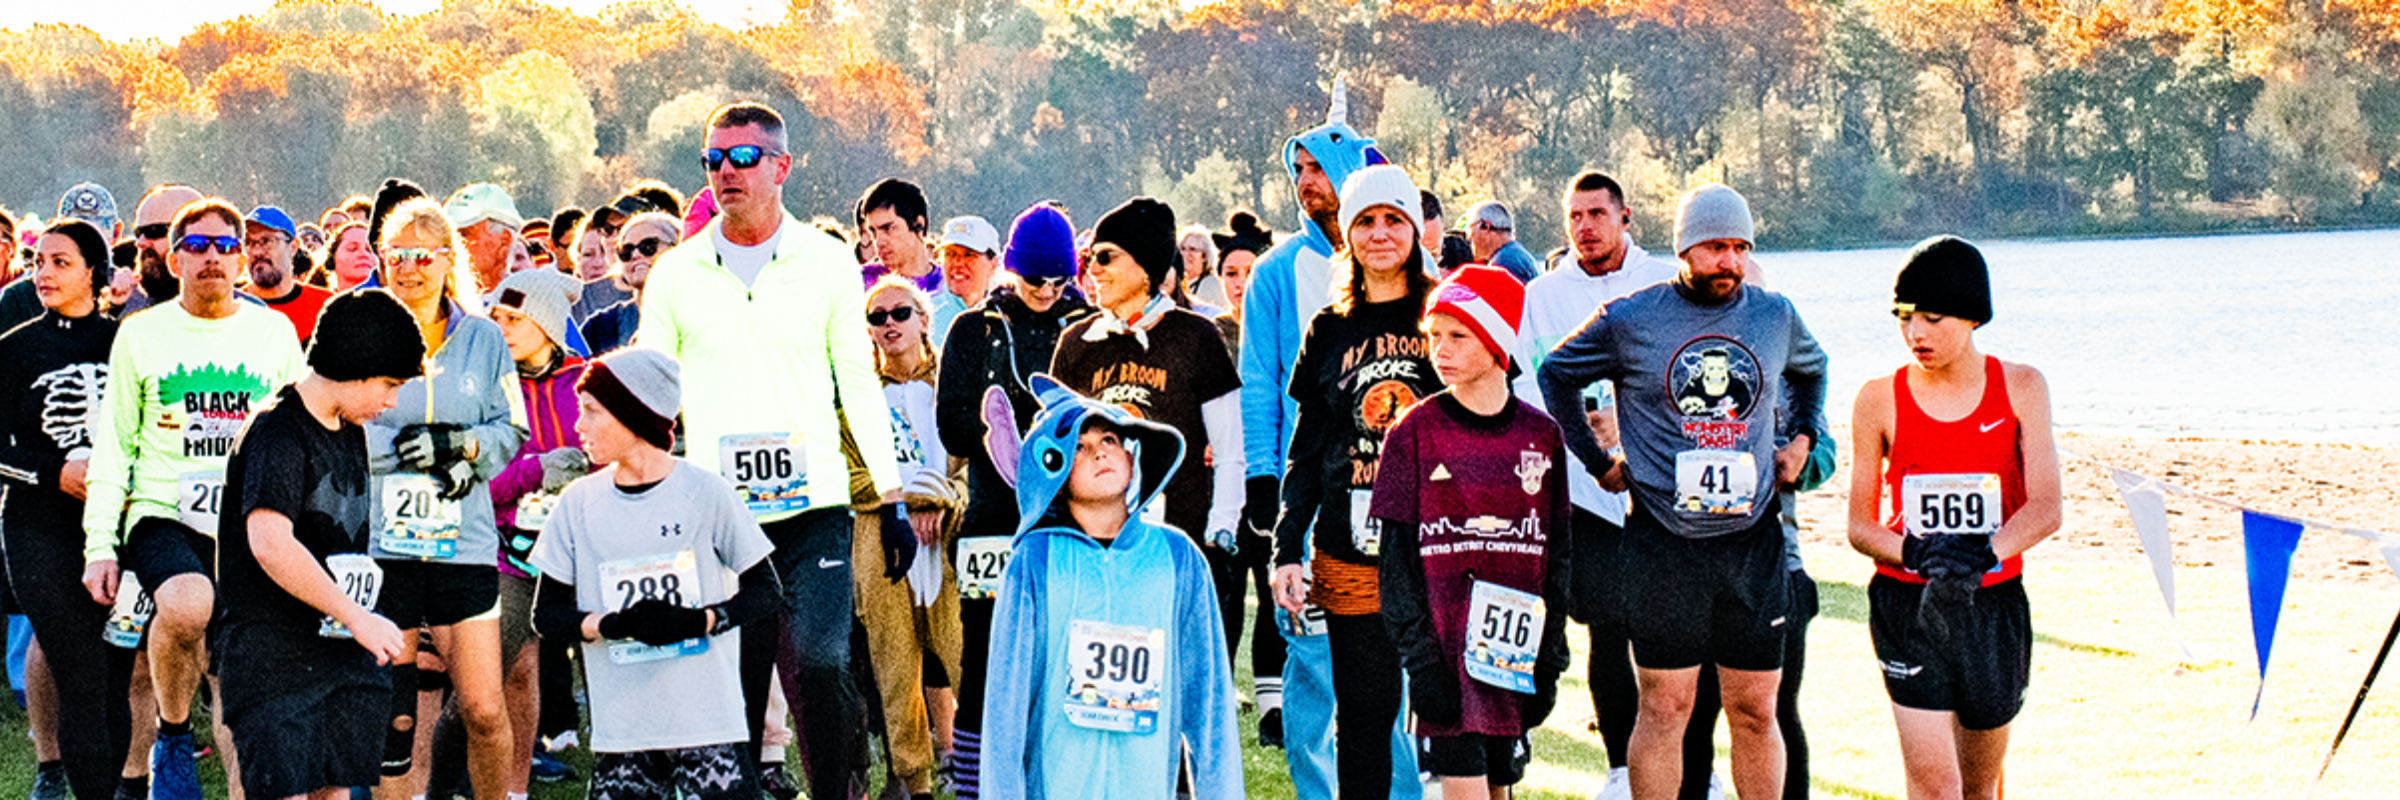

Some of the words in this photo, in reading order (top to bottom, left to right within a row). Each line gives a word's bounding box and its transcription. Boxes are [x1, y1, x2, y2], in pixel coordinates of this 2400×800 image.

[1340, 339, 1369, 376] MY
[1092, 362, 1116, 393] MY
[1119, 361, 1167, 391] BROOM
[1352, 358, 1421, 394] BROKE
[183, 390, 251, 414] BLACK
[734, 447, 793, 482] 506
[1699, 464, 1732, 494] 41
[1920, 492, 1985, 529] 569
[344, 571, 375, 607] 219
[616, 572, 683, 611] 288
[1482, 603, 1532, 648] 516
[1085, 641, 1151, 685] 390
